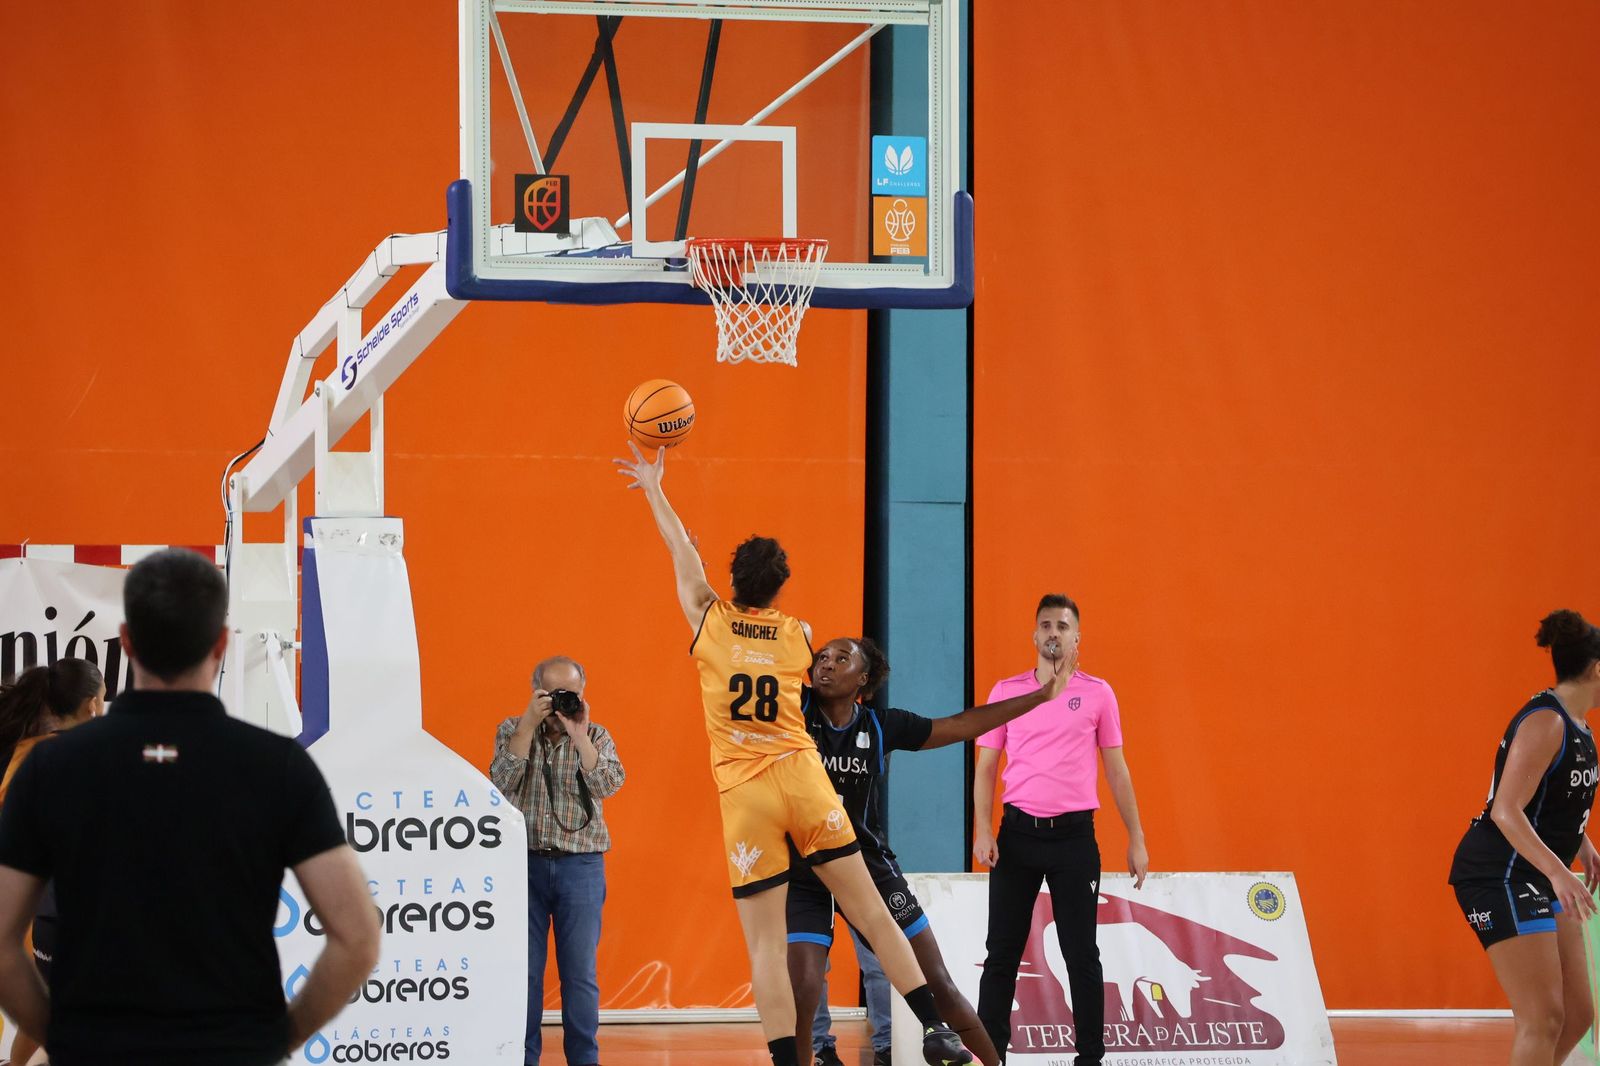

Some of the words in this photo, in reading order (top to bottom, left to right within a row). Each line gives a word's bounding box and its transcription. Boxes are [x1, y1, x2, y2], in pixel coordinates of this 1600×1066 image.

[876, 178, 889, 186] LF
[890, 247, 911, 255] FEB
[356, 322, 391, 366] Schelde
[390, 292, 419, 328] Sports
[731, 620, 778, 641] SÁNCHEZ
[0, 606, 134, 702] nión
[728, 673, 779, 722] 28
[823, 755, 869, 775] MUSA
[1570, 765, 1598, 788] DOM
[355, 788, 501, 811] CTEAS
[345, 811, 502, 853] breros
[367, 875, 494, 896] CTEAS
[893, 902, 917, 921] ZKOITIA
[372, 957, 470, 974] TEAS
[348, 976, 470, 1004] breros
[334, 1025, 450, 1041] LÁCTEAS
[1017, 1023, 1153, 1049] TERERA
[1171, 1021, 1268, 1046] ALISTE
[332, 1039, 450, 1064] cobreros
[1189, 1056, 1252, 1065] PROTEGIDA
